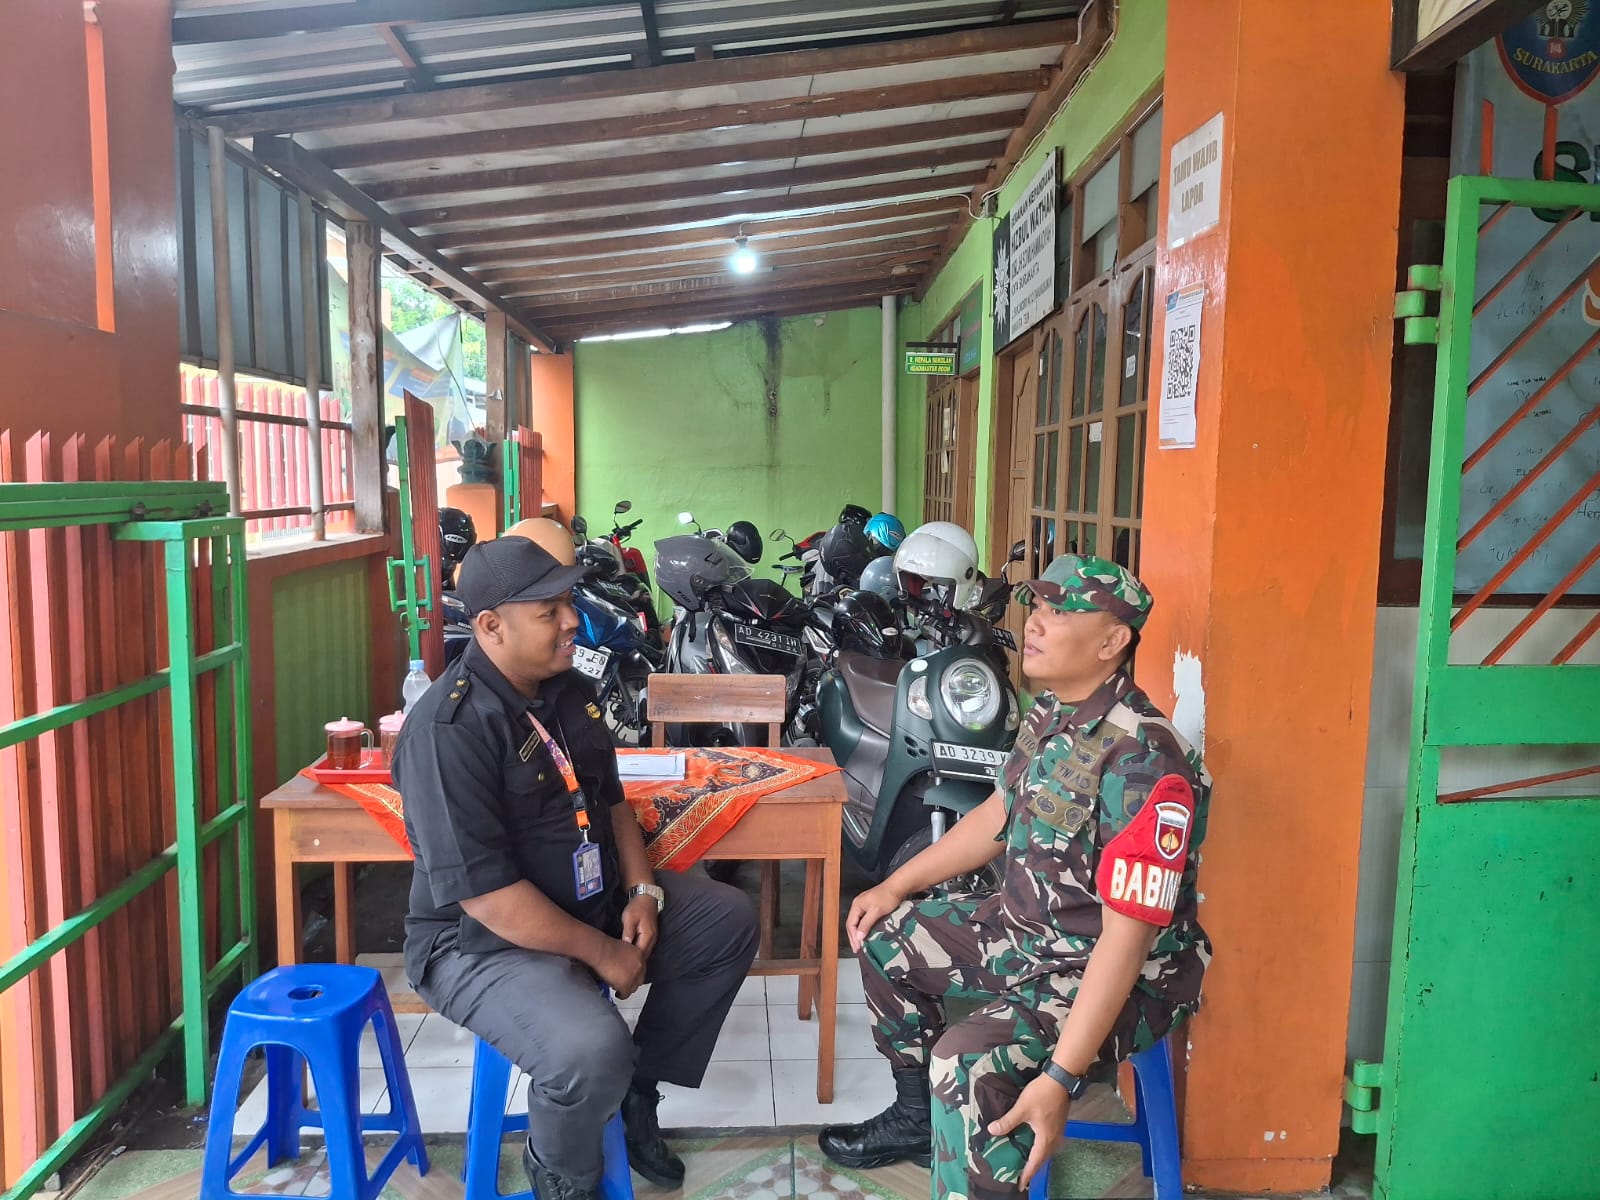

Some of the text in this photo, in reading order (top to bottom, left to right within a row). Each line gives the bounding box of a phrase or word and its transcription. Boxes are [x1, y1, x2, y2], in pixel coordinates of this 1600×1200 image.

[1513, 47, 1598, 74] SURAKARTA
[1173, 139, 1218, 187] TAMU WAJIB
[1030, 188, 1054, 234] WATHAN
[1181, 181, 1204, 213] LAPOR
[738, 626, 752, 636] AD
[758, 632, 782, 643] 4231
[940, 746, 956, 757] AD
[961, 748, 996, 763] 3239
